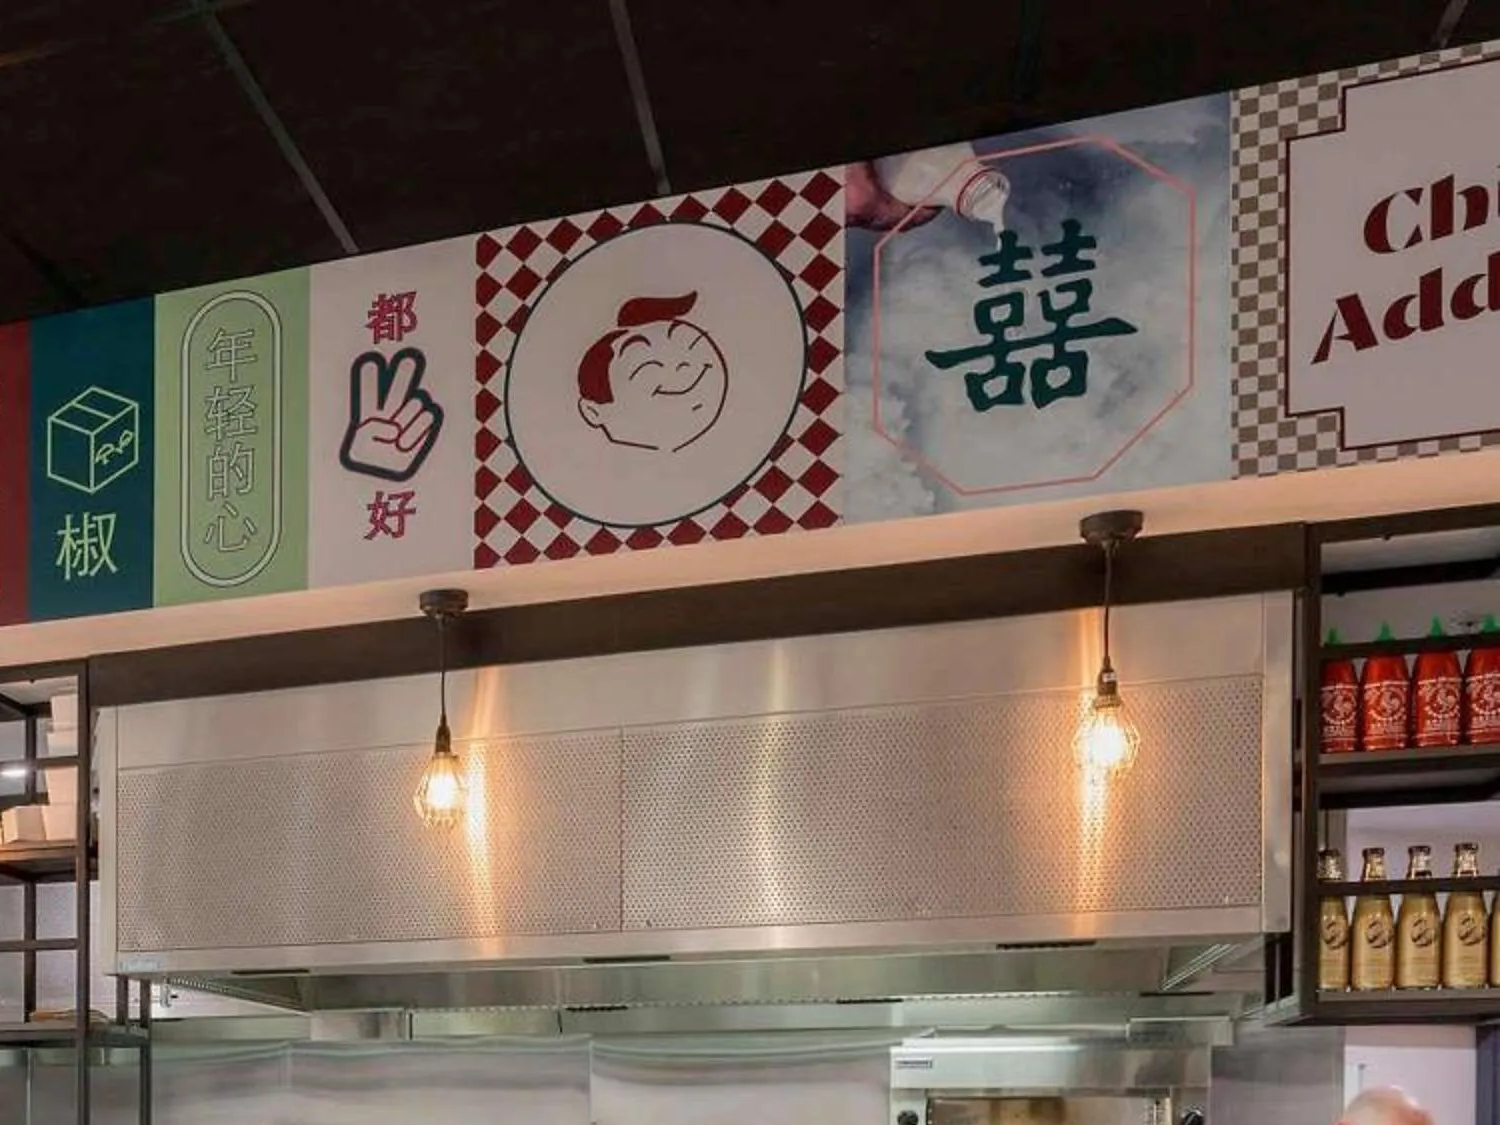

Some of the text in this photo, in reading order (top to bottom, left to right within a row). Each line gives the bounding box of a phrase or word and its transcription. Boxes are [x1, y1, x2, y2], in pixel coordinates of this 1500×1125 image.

[1364, 165, 1500, 254] Ch
[204, 328, 258, 554] 年轻的心
[365, 291, 417, 541] 都 好
[56, 511, 119, 580] 椒
